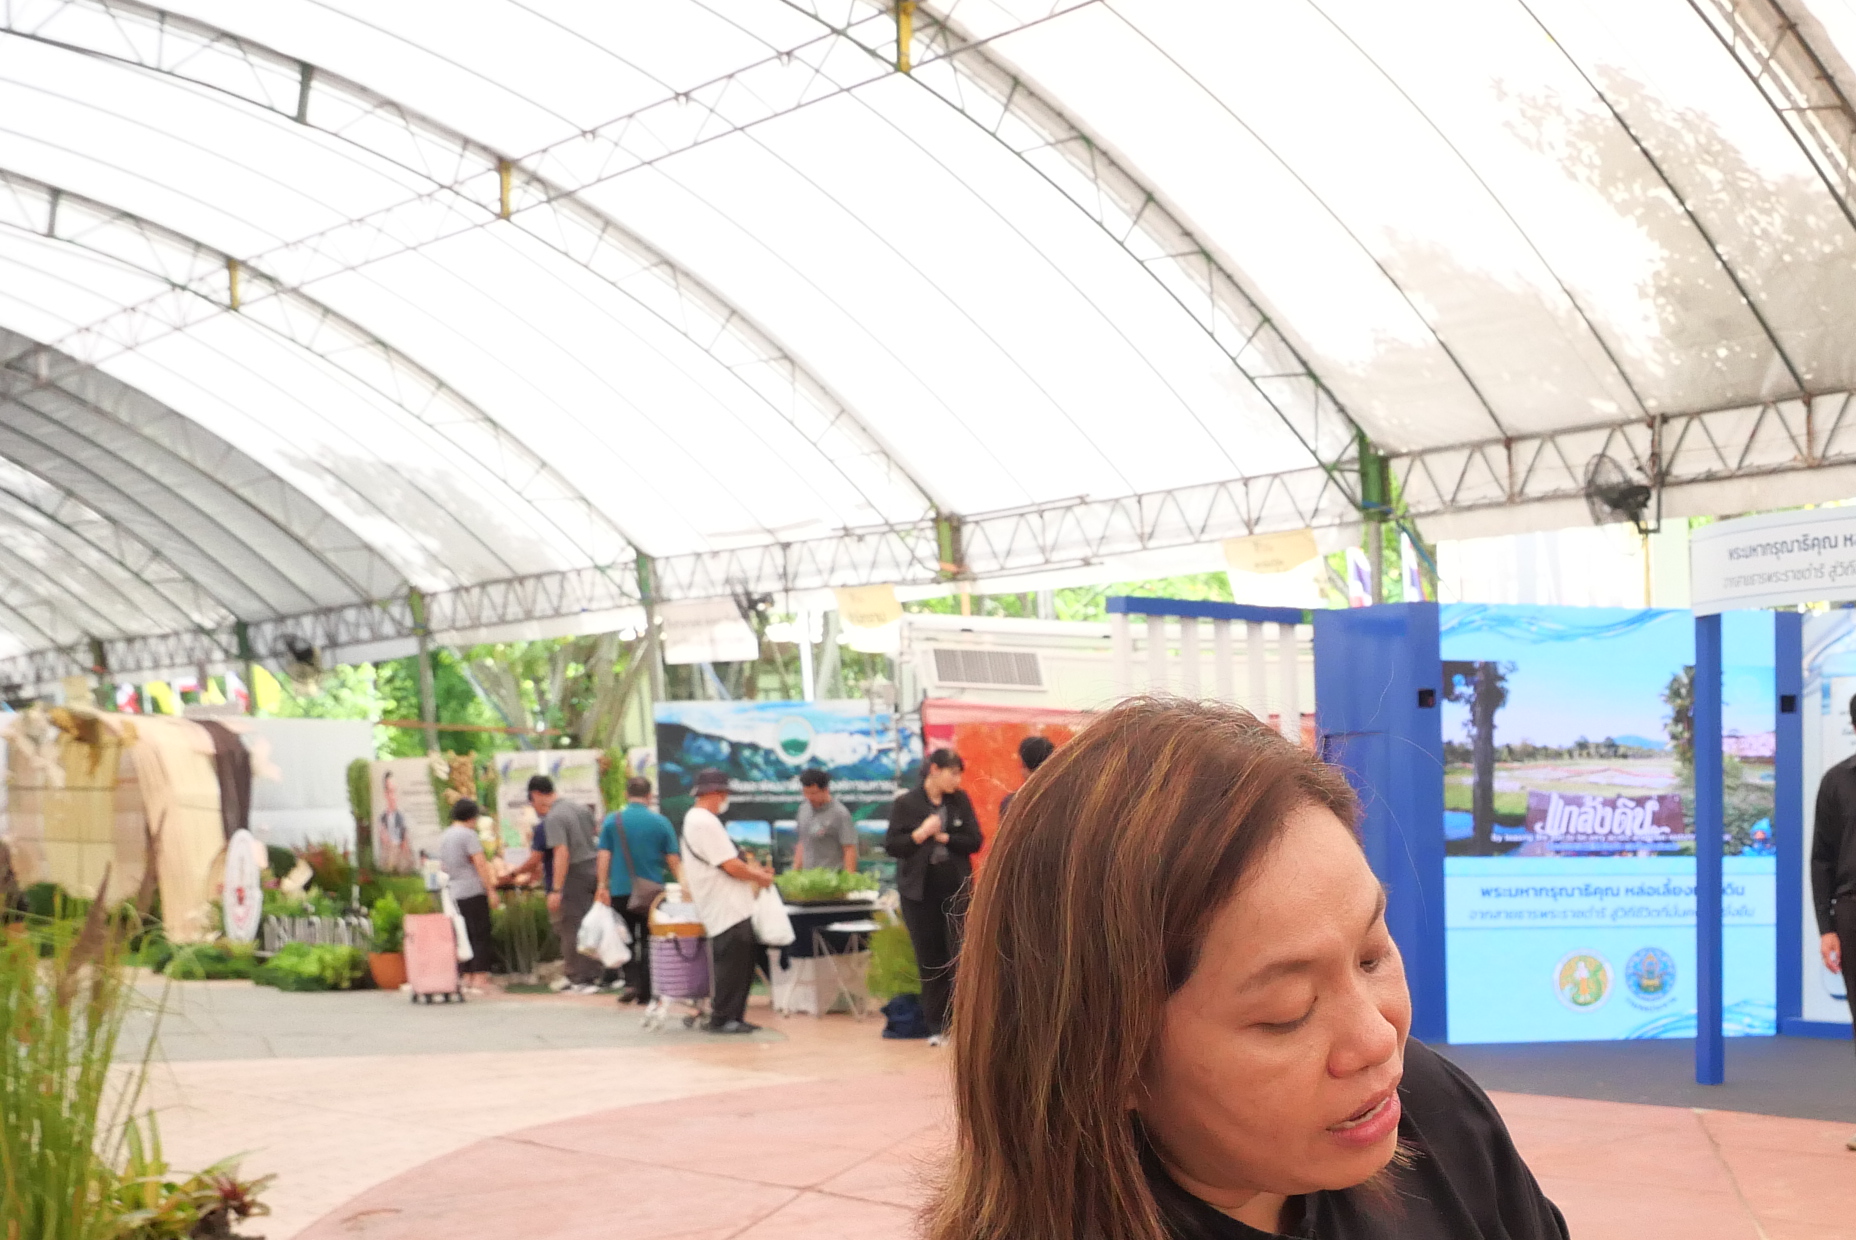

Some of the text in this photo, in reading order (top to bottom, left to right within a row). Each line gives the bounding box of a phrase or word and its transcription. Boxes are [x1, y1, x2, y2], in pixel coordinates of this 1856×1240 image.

[1727, 533, 1838, 562] พระมหากรุณาธิคุณ
